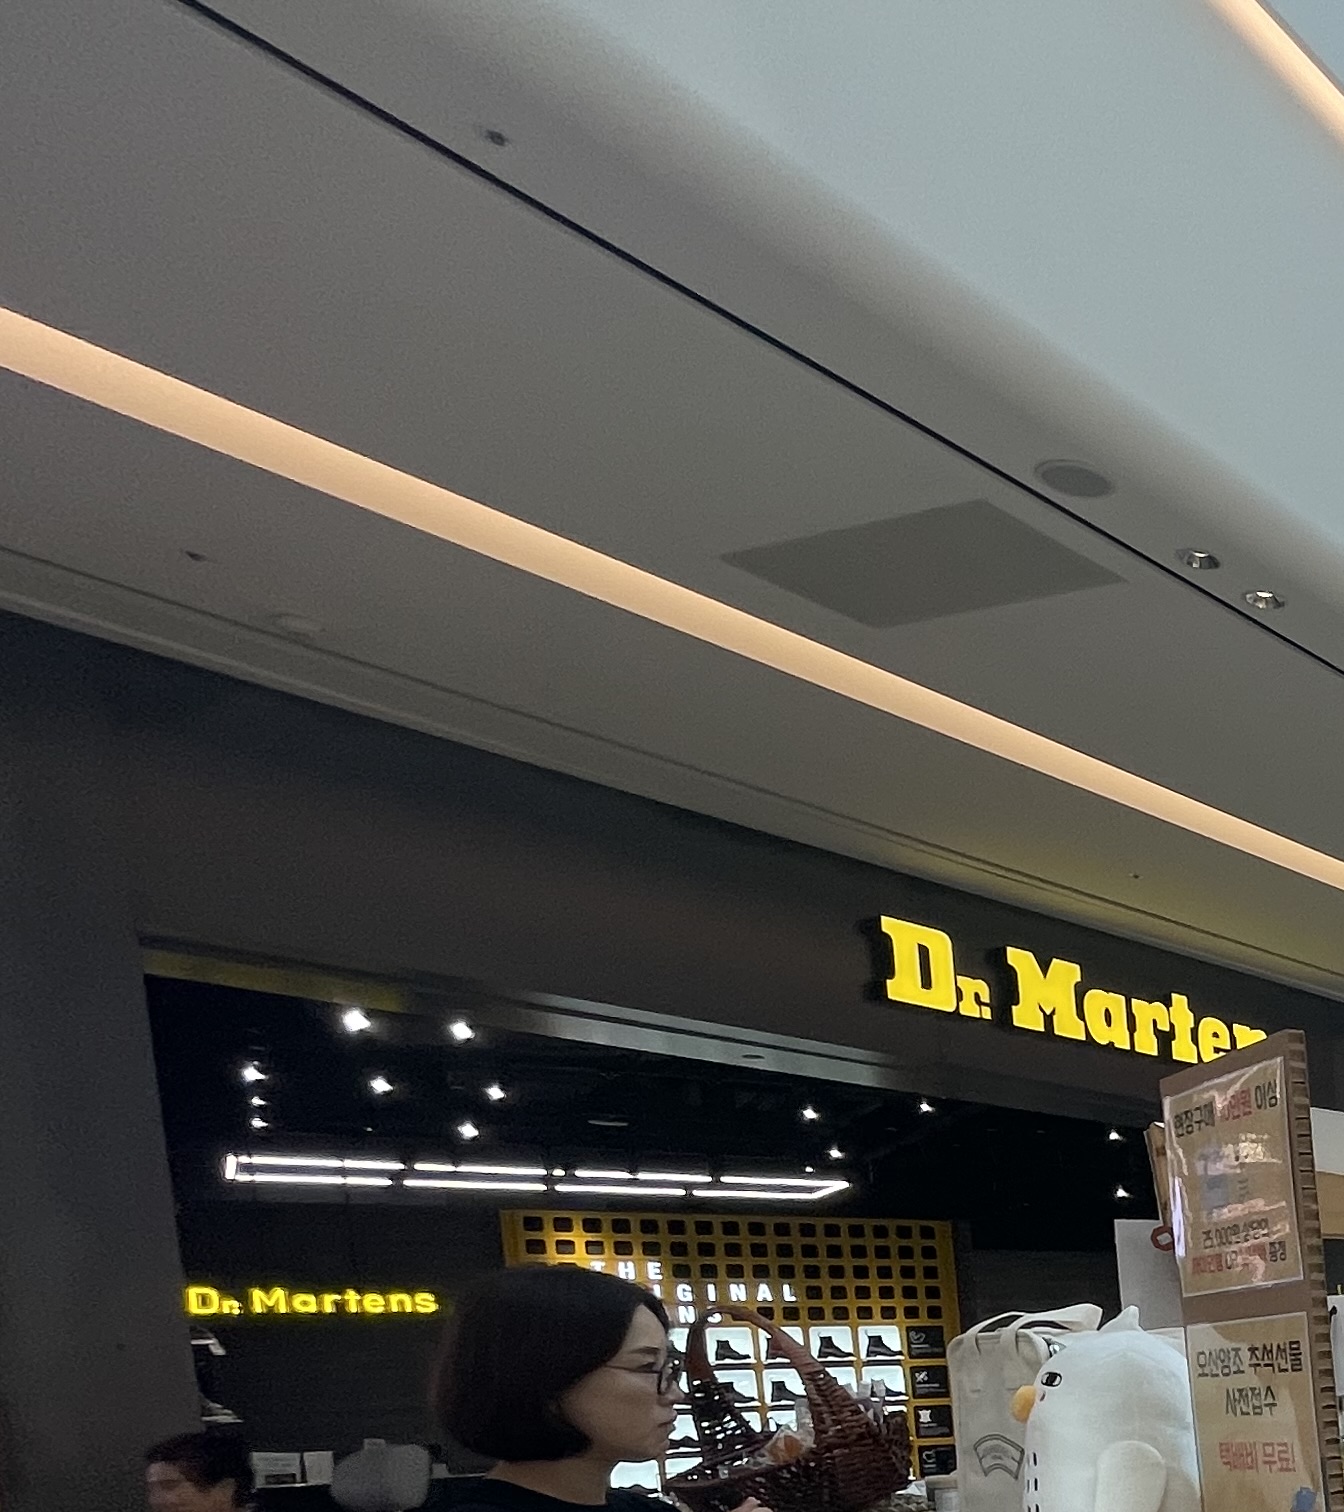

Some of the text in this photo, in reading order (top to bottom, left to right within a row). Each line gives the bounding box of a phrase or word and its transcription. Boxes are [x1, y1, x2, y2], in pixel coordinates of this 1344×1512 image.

[880, 915, 992, 1020] Dr.
[186, 1286, 439, 1316] Dr. Martens
[1197, 1340, 1303, 1378] 오산양조 추석선물
[1225, 1385, 1278, 1417] 사전접수
